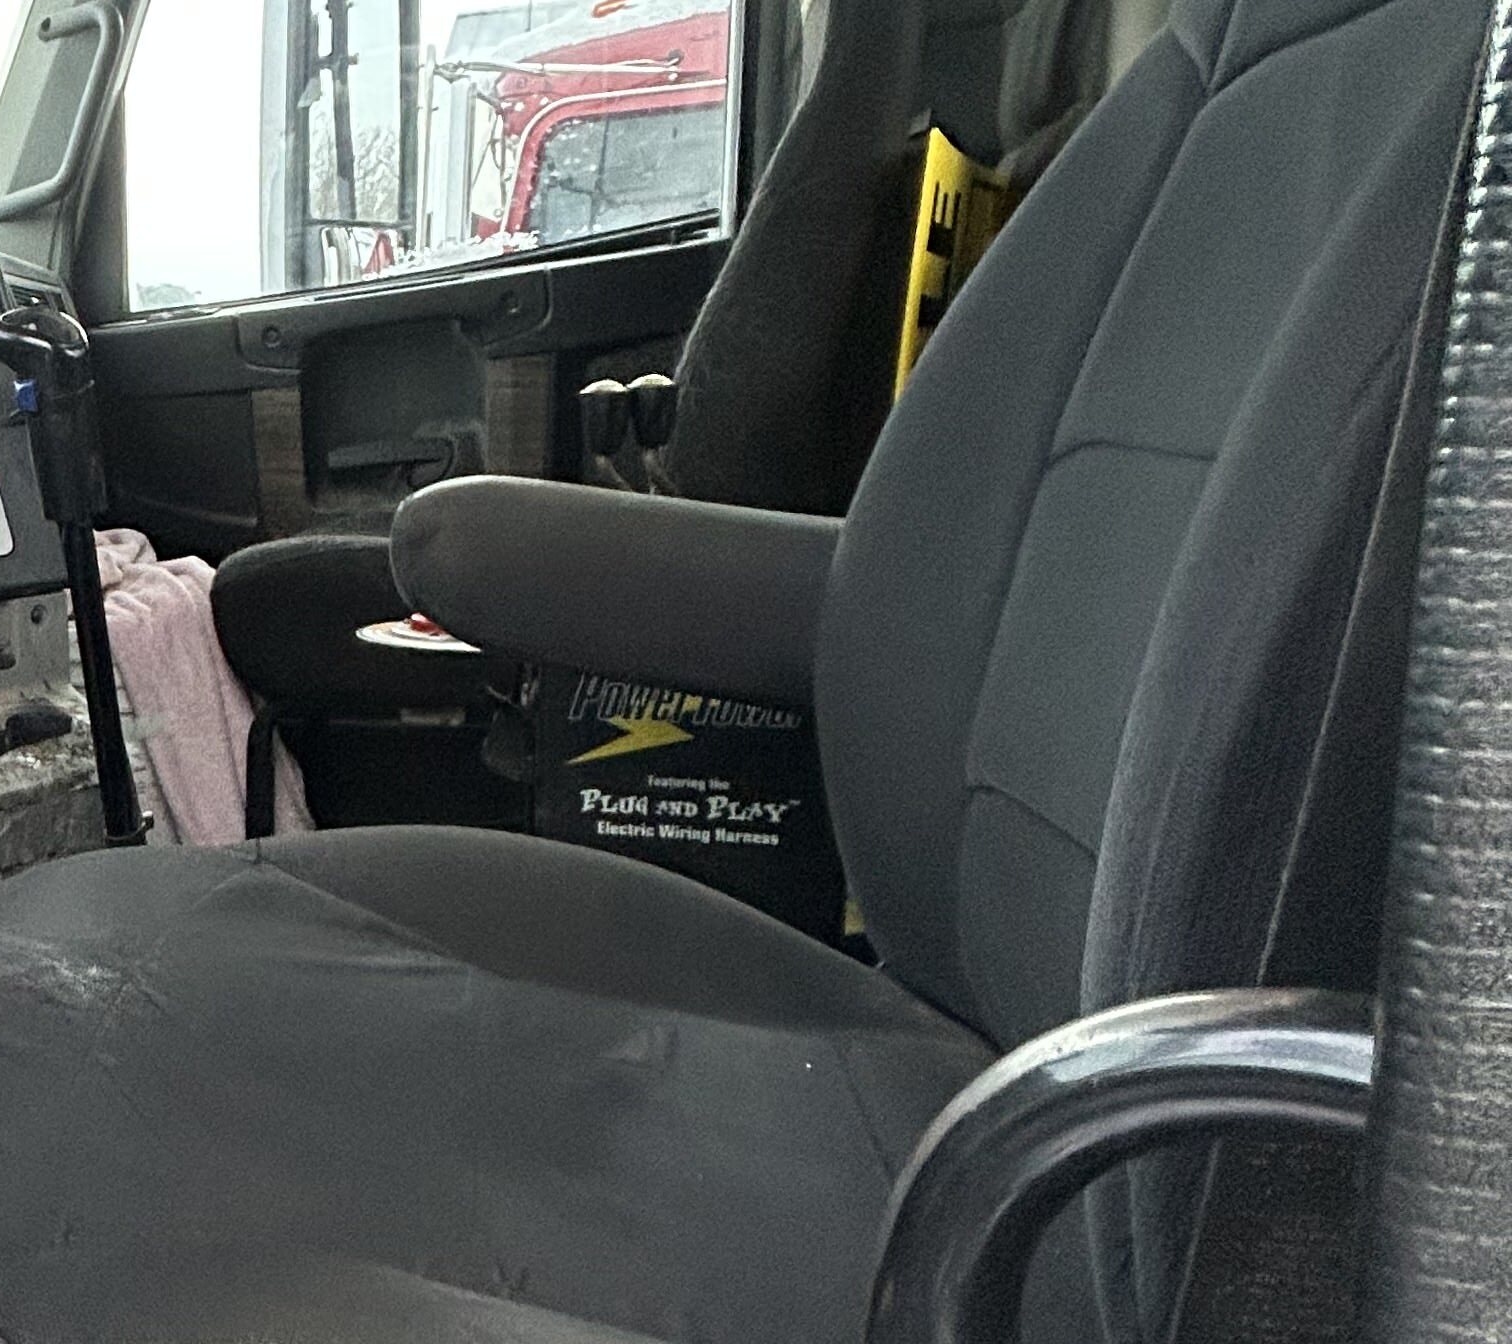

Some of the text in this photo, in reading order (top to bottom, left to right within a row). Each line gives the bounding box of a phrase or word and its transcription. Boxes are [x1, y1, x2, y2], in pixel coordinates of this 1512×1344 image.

[648, 774, 730, 792] Featuring the
[580, 788, 649, 816] PLUG
[655, 799, 698, 818] AND
[597, 821, 780, 846] Electric Wiring Harness
